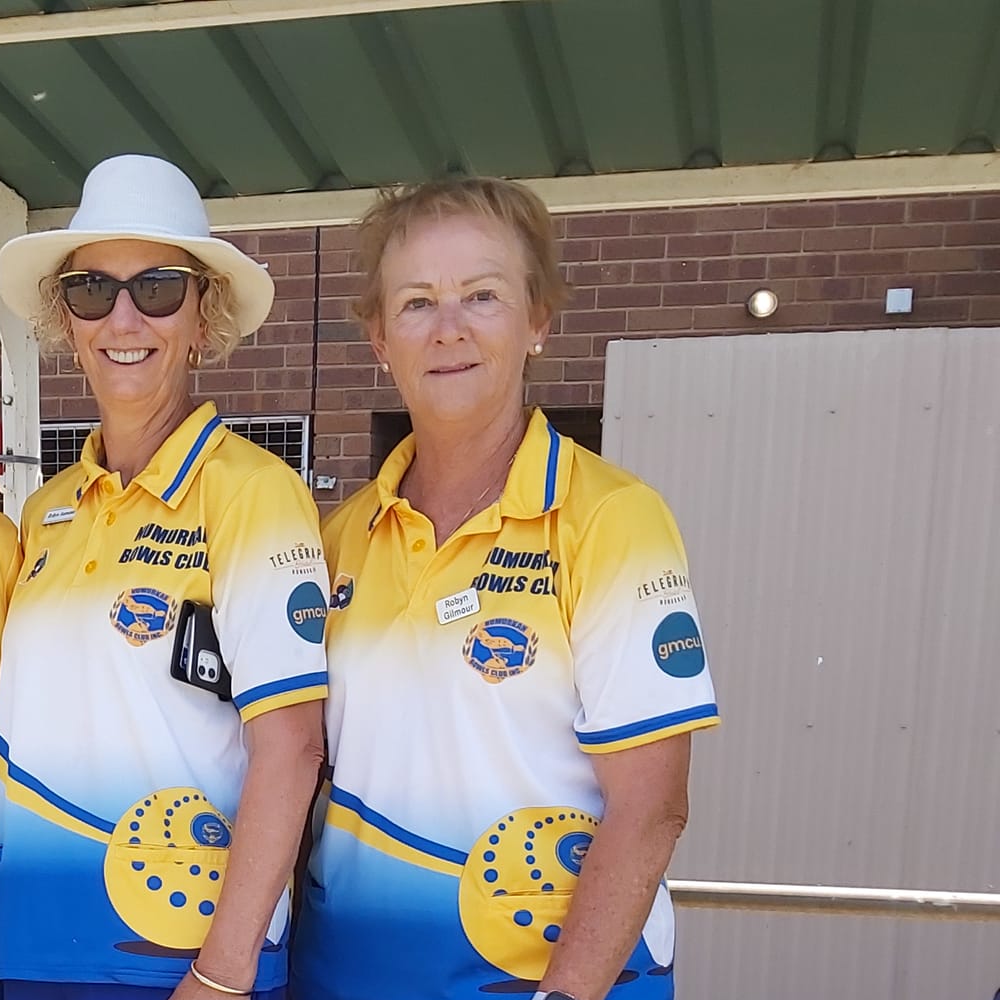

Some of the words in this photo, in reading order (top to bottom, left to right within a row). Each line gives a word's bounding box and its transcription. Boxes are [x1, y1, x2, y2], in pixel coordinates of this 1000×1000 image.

[118, 545, 173, 566] BOWLS
[269, 546, 321, 568] TELEGRAP
[443, 603, 475, 620] Gilmour
[444, 594, 469, 608] Robyn
[658, 636, 702, 660] gmcu
